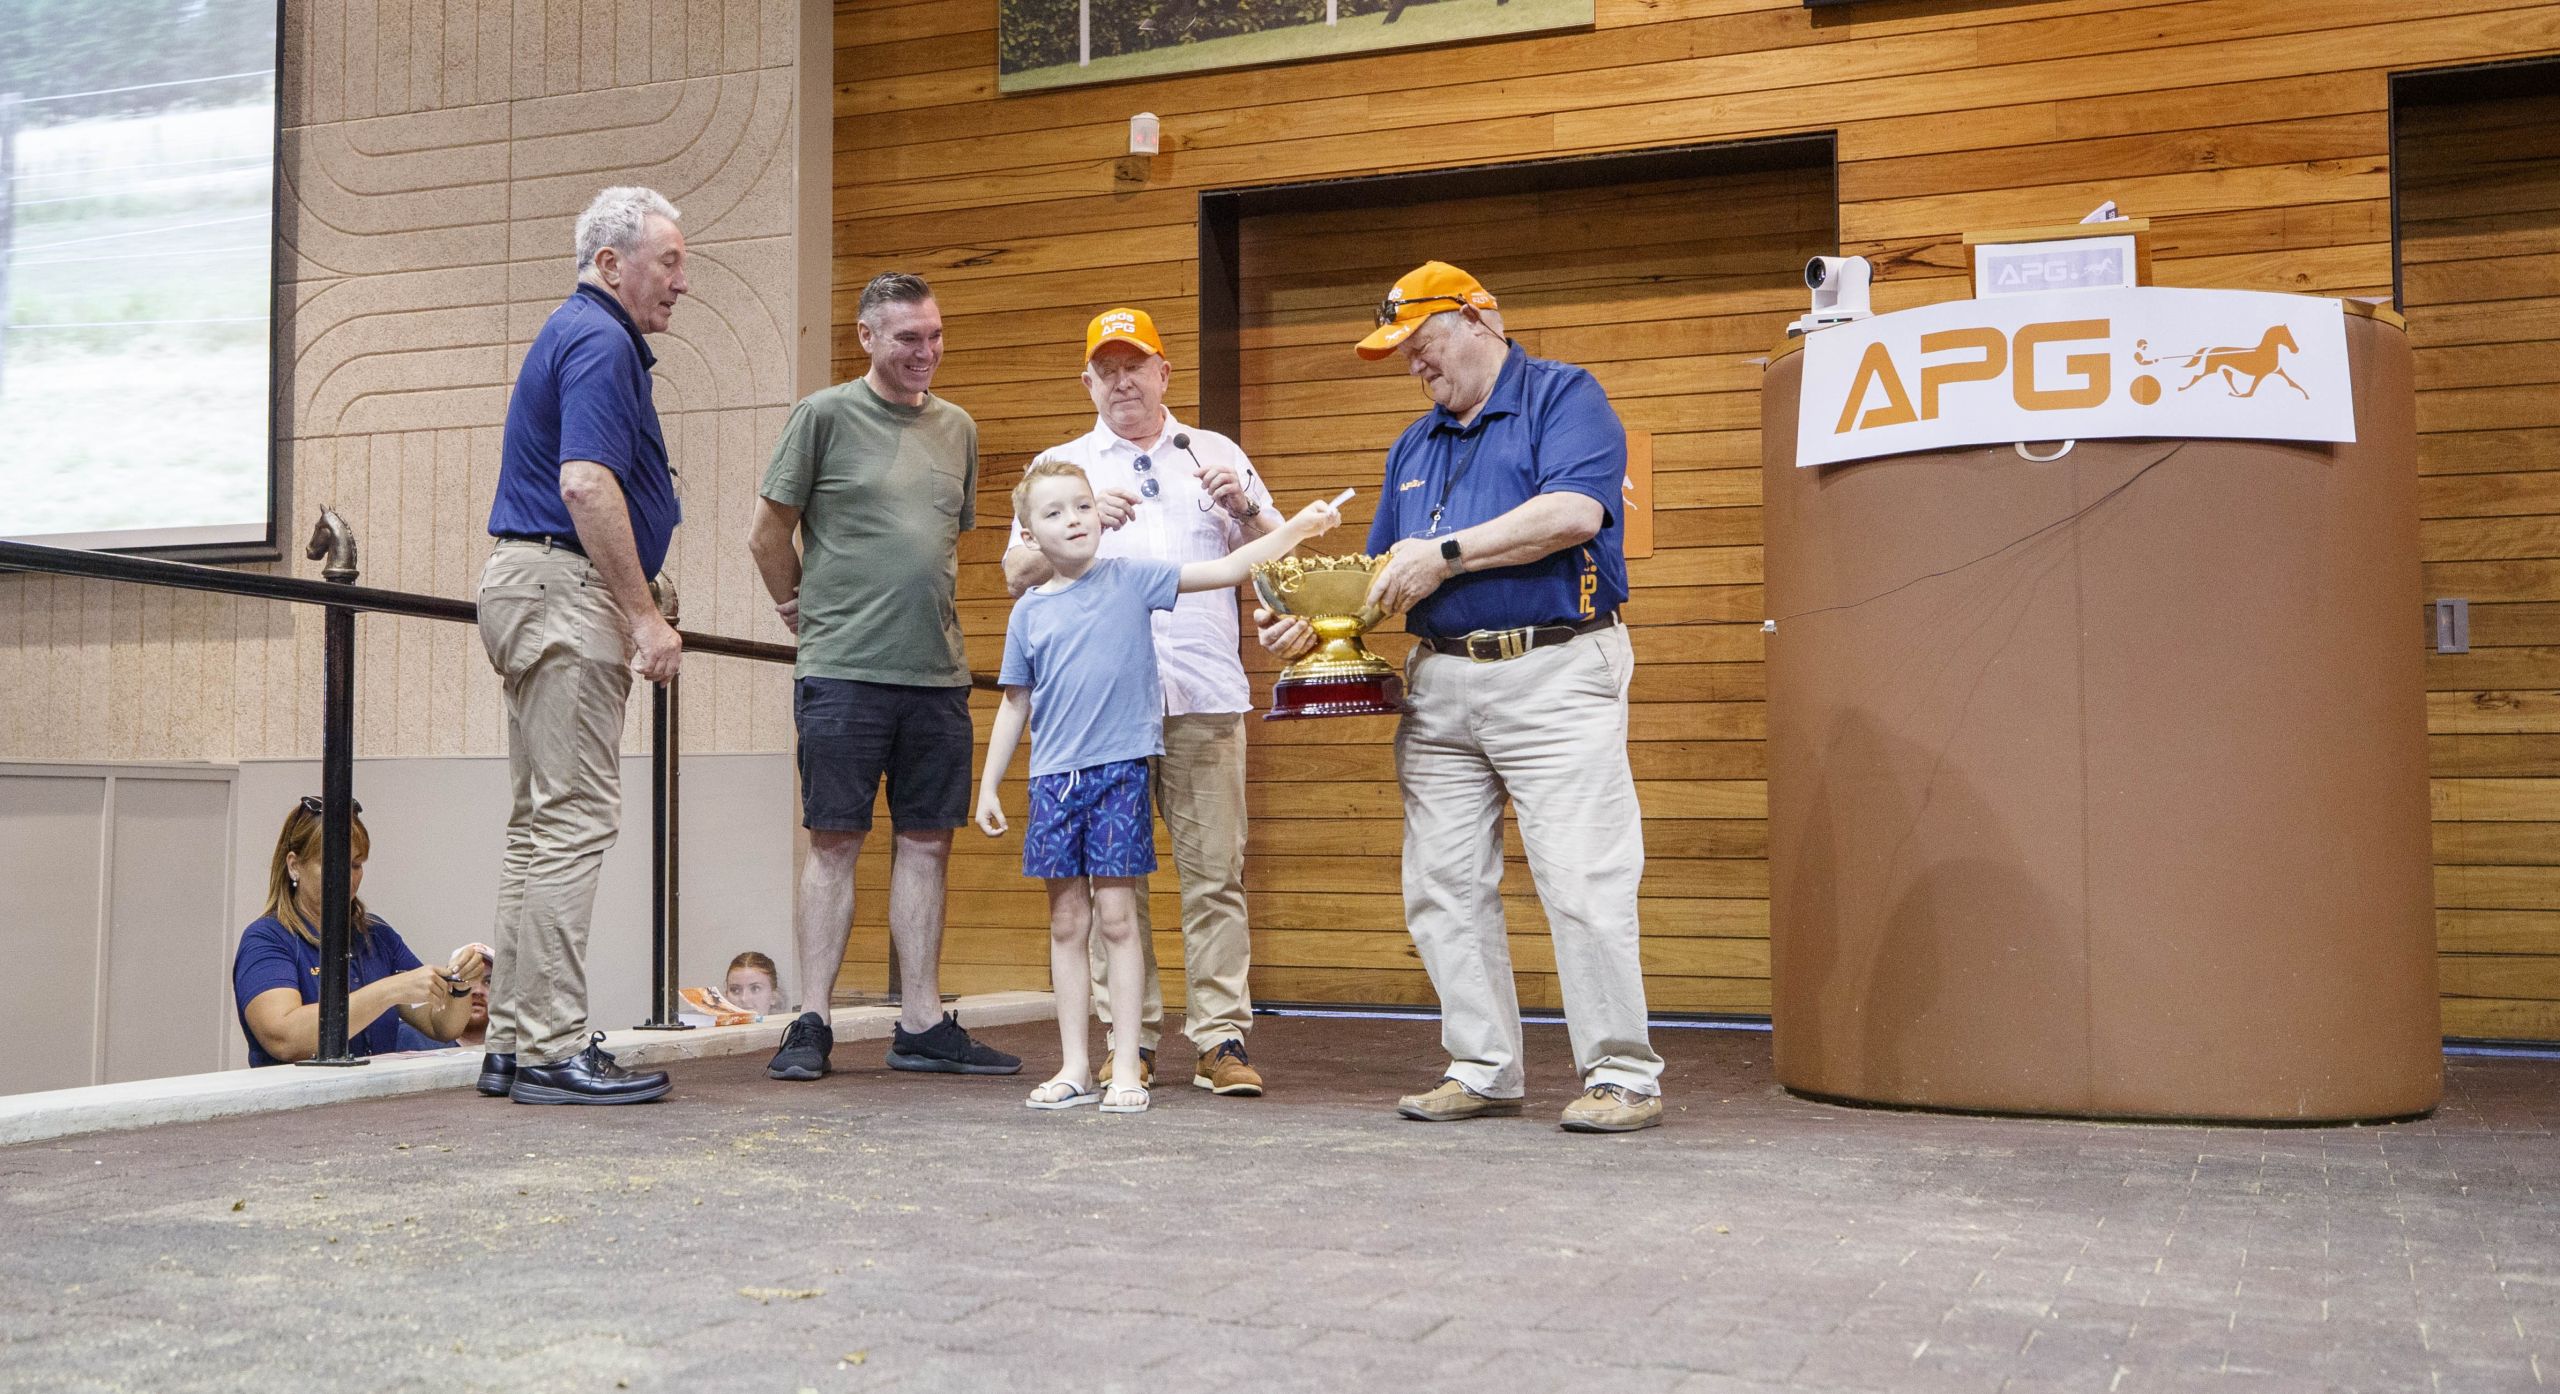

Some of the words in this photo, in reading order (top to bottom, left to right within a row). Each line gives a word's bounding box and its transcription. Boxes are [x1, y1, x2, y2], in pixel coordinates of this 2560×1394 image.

[1997, 260, 2067, 286] APG
[1102, 322, 1135, 336] APG
[1834, 319, 2111, 434] APG
